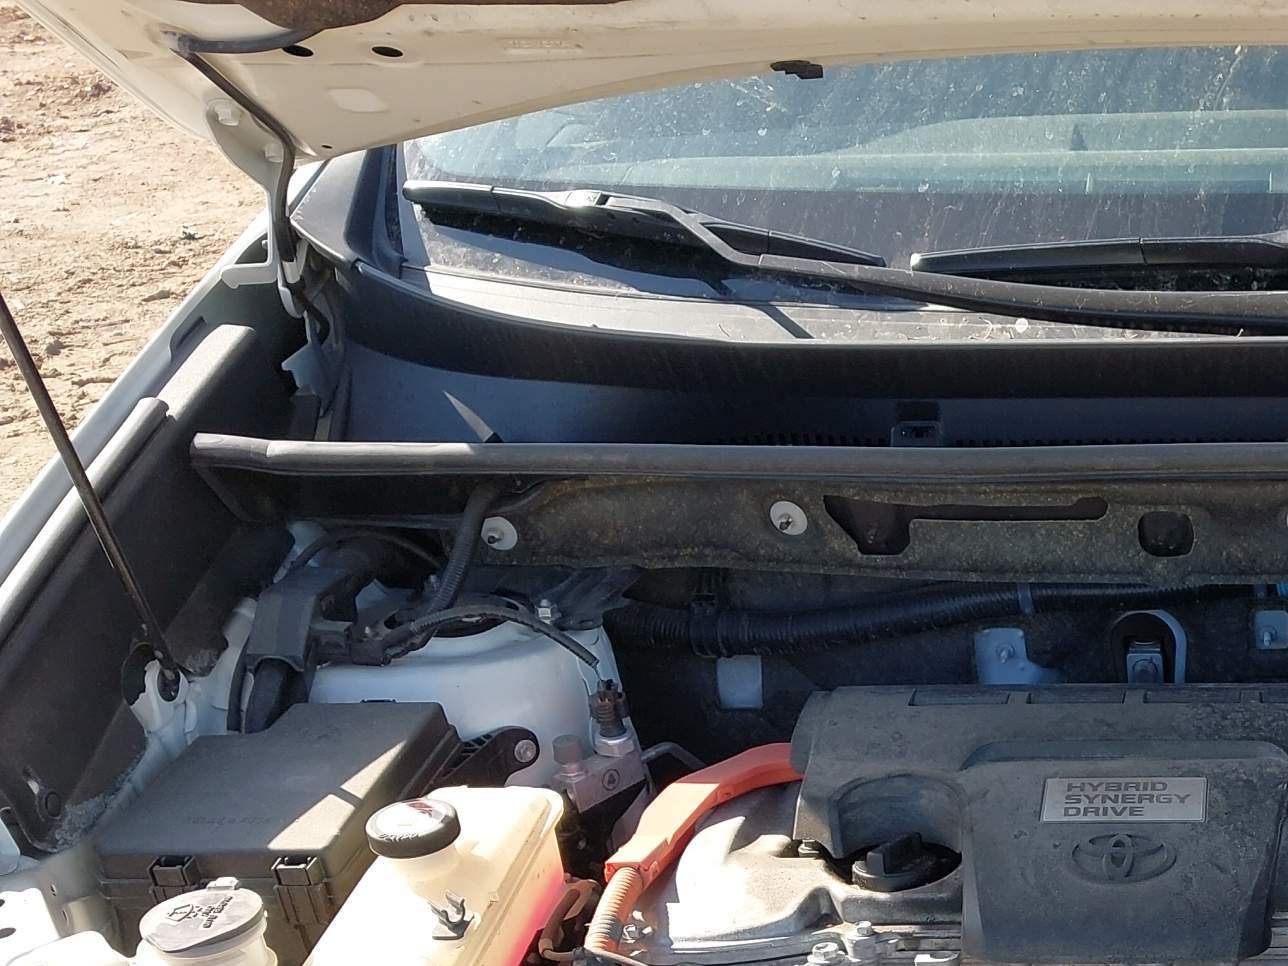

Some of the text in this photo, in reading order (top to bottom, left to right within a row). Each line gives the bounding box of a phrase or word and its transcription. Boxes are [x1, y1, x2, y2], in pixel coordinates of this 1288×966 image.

[1067, 782, 1168, 792] HYBRID
[1064, 794, 1191, 804] SYNERGY
[1064, 806, 1145, 817] DRIVE
